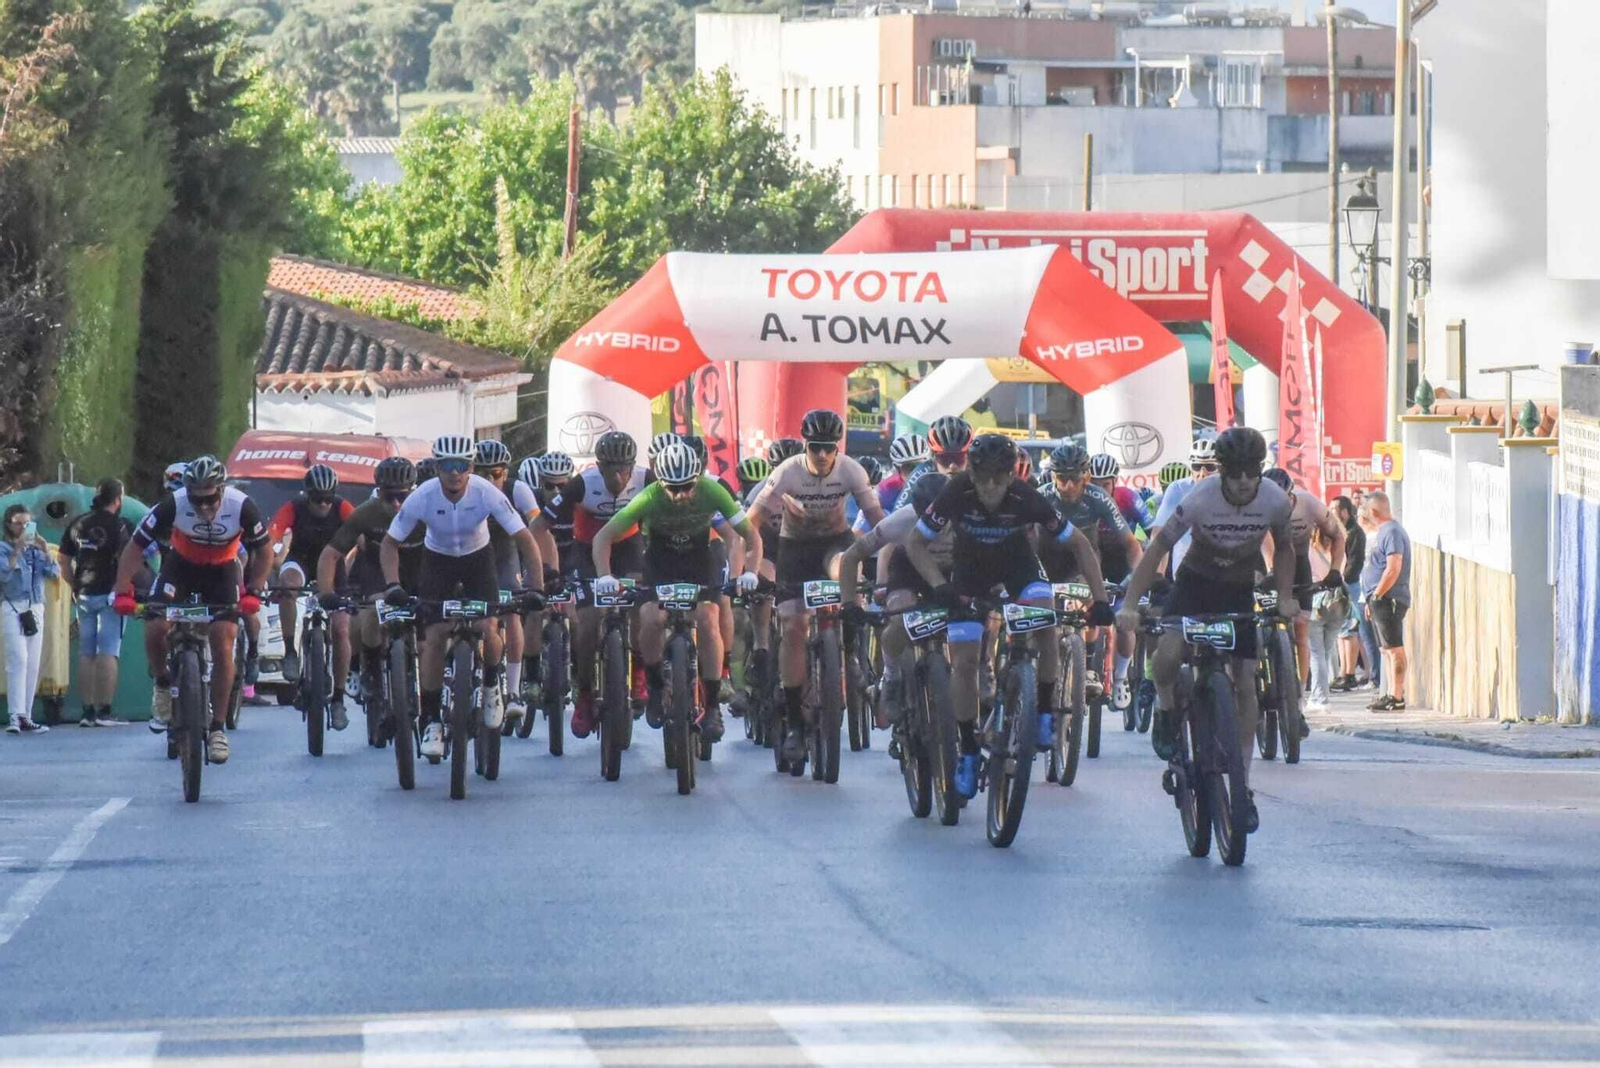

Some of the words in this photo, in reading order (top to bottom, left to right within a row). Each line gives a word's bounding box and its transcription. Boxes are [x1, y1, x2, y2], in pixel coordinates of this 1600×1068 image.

[761, 268, 948, 303] TOYOTA
[760, 312, 798, 343] A.
[802, 314, 952, 345] TOMAX
[574, 331, 681, 353] HYBRID
[1036, 335, 1145, 361] HYBRID
[235, 449, 307, 461] home
[316, 450, 382, 467] team
[931, 512, 946, 526] LG
